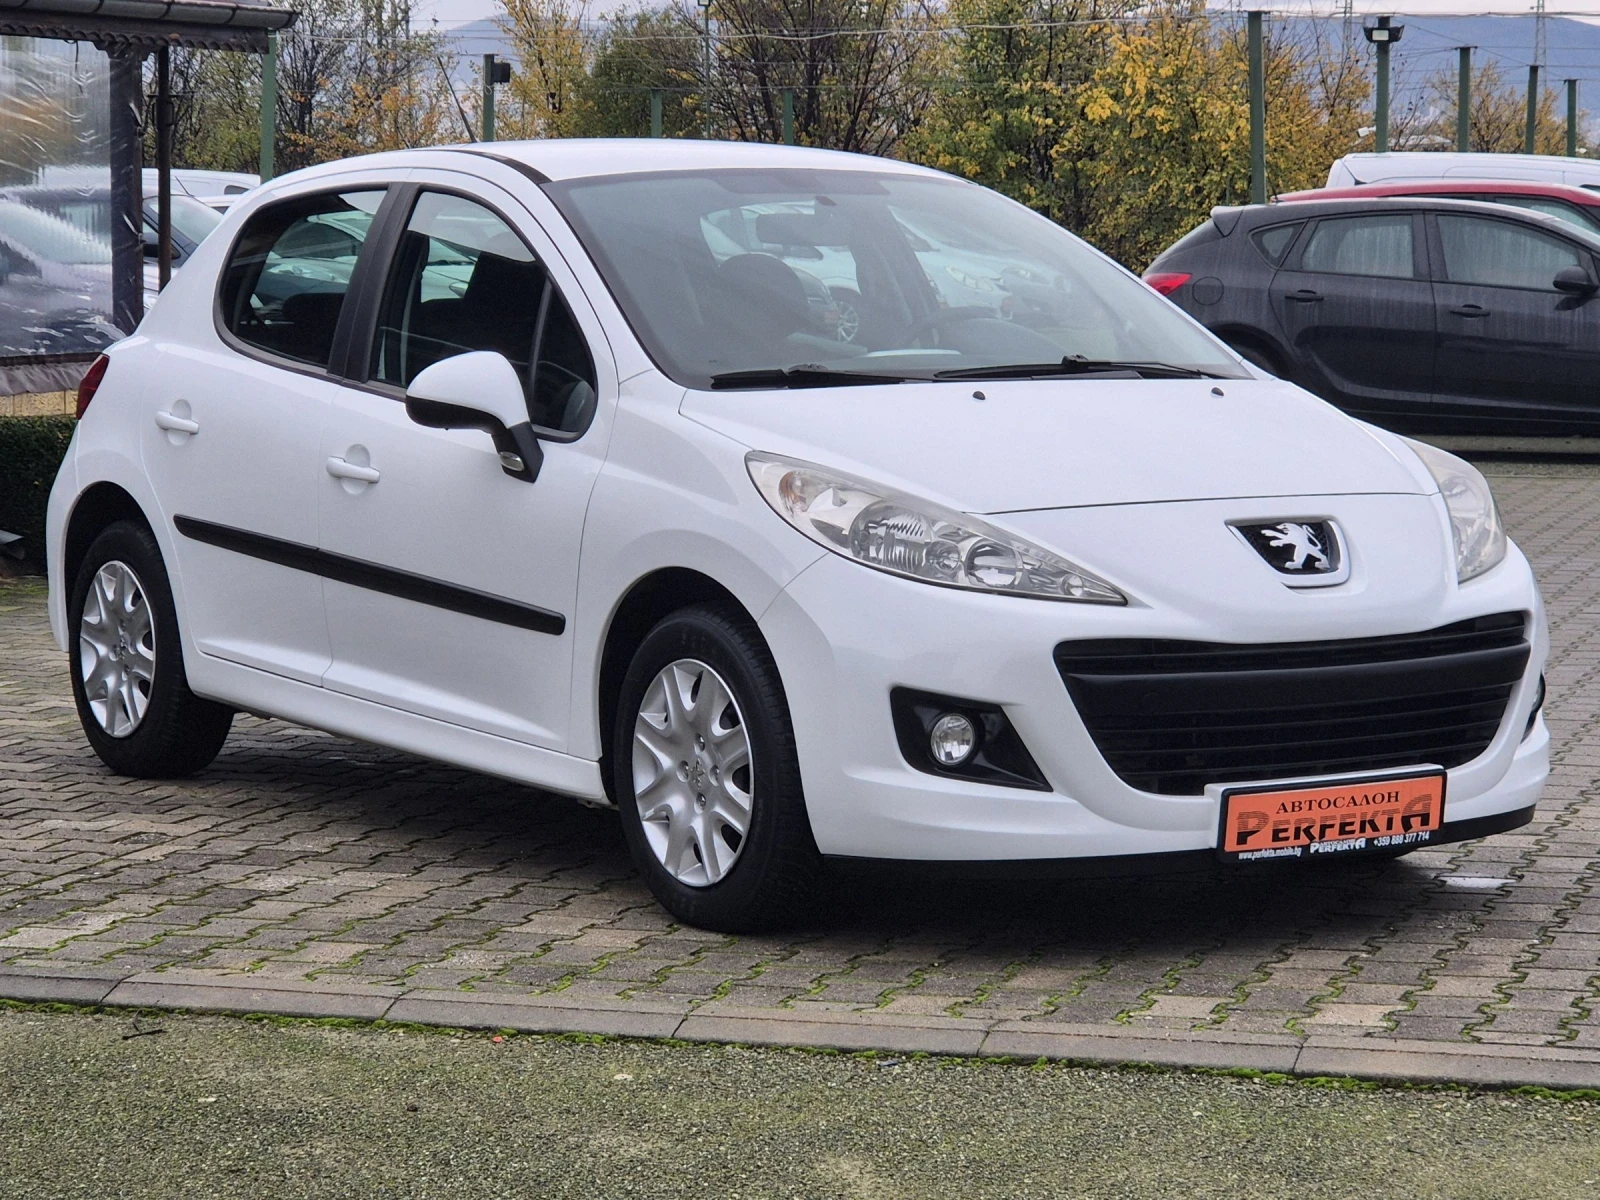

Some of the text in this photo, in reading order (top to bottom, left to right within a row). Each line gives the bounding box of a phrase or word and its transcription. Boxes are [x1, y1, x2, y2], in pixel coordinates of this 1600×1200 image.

[1276, 791, 1399, 813] АВТОСАЛОН
[1236, 794, 1432, 845] PERFEKTA
[1373, 836, 1390, 847] +359
[1404, 833, 1416, 843] 377
[1417, 831, 1430, 841] 714
